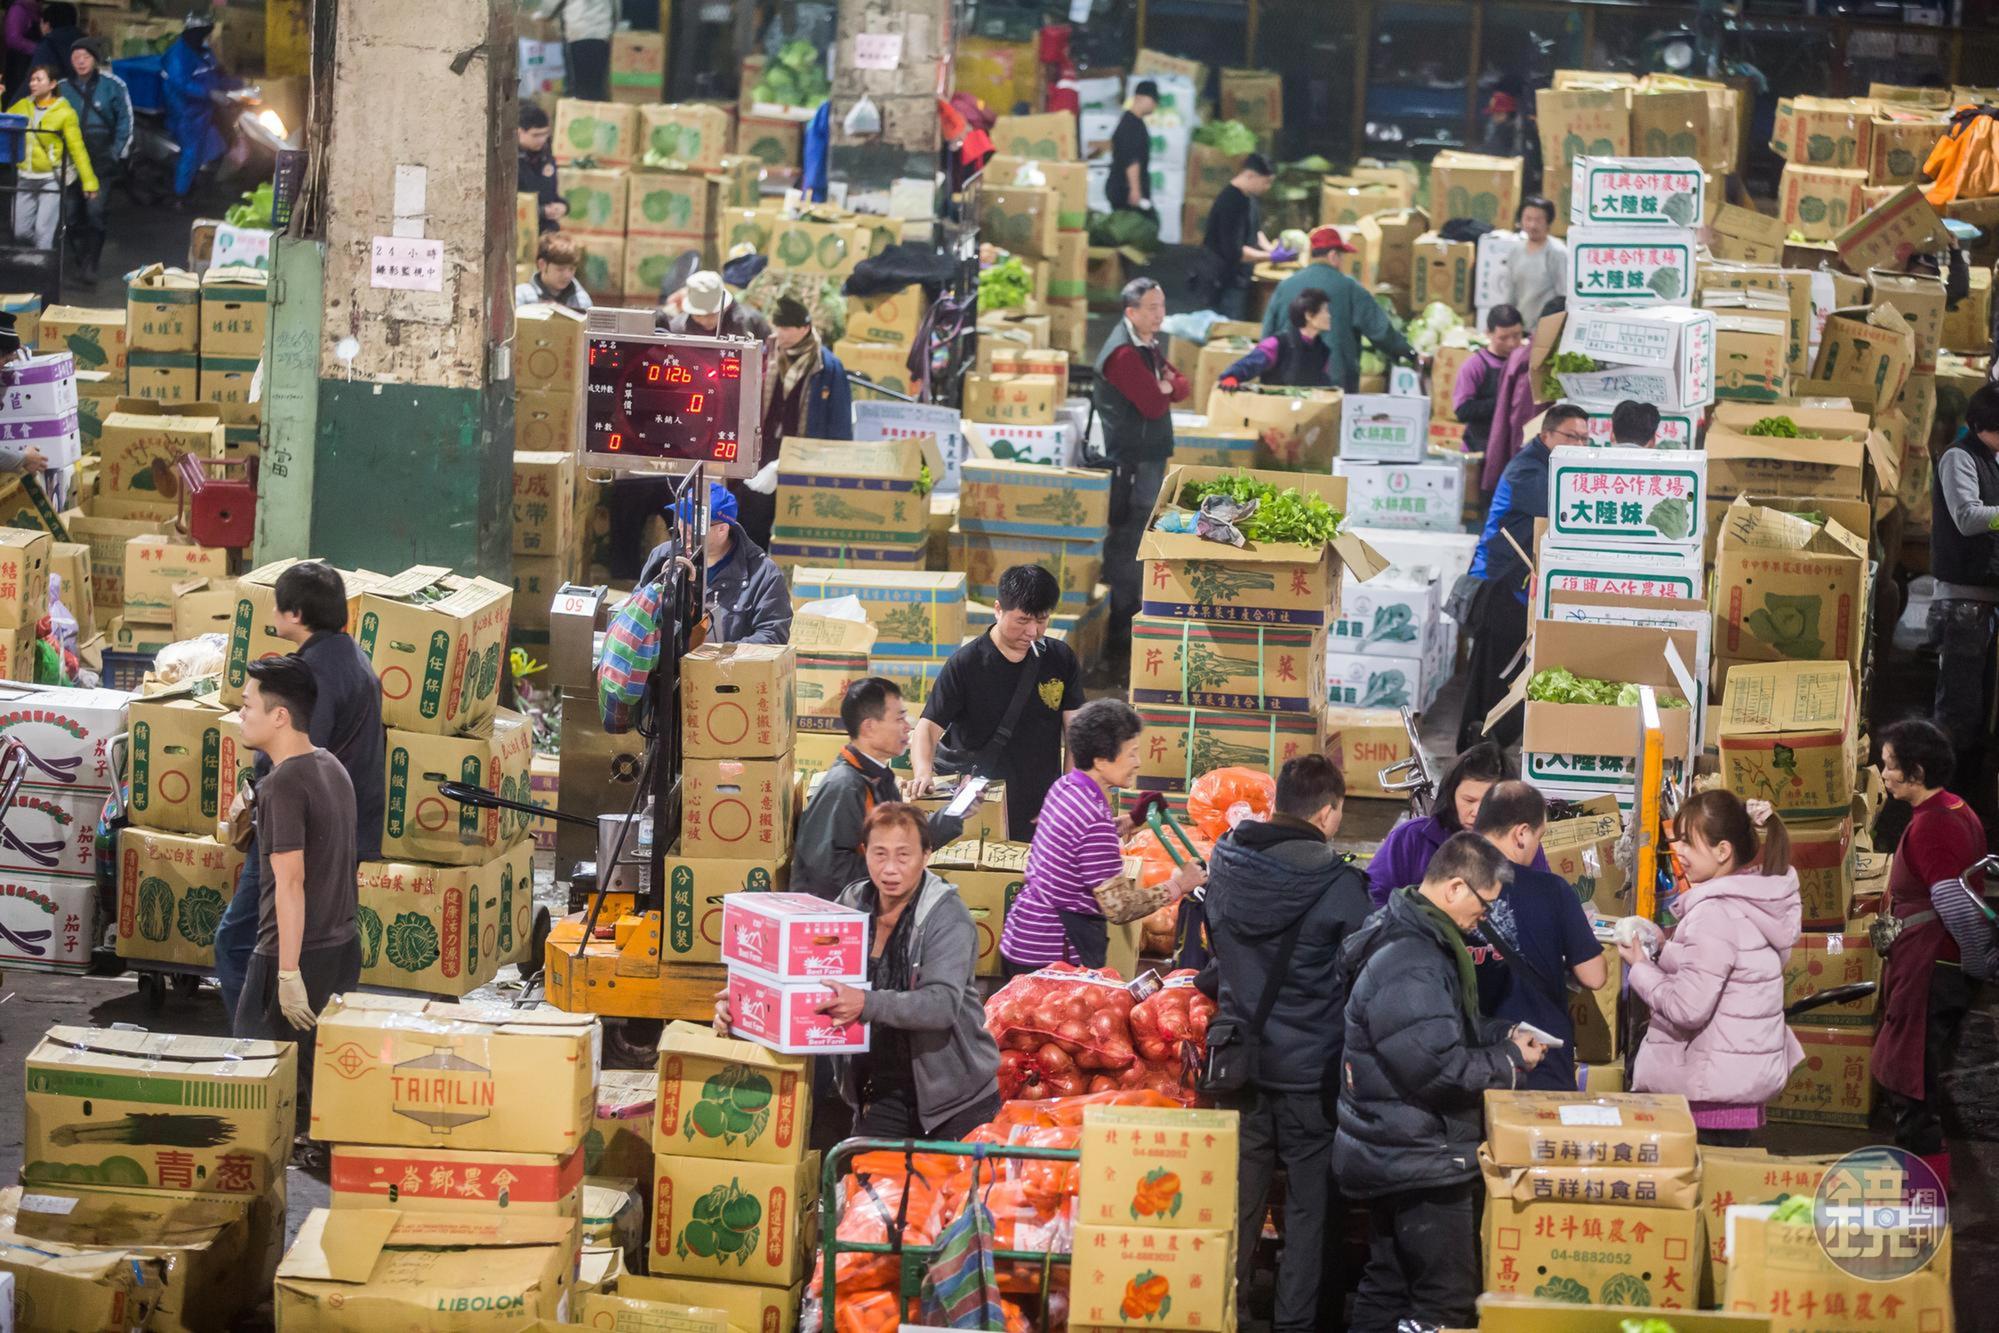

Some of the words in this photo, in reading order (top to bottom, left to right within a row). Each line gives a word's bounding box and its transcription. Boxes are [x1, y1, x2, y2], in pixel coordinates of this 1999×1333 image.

[1602, 175, 1690, 192] 復興合作農場
[1602, 195, 1658, 214] 大陸妹
[1587, 250, 1677, 266] 復興合作農場
[1587, 270, 1644, 289] 大陸妹
[599, 341, 617, 349] 品名
[595, 422, 613, 431] 件數
[654, 414, 682, 424] 承銷人
[718, 431, 736, 440] 重量
[714, 442, 737, 458] 20
[1572, 474, 1685, 497] 復興合作農場
[1571, 500, 1643, 525] 大陸妹
[1291, 569, 1311, 595] 菜
[360, 616, 379, 658] 精緻
[1146, 648, 1164, 676] 芹
[1278, 655, 1297, 682] 菜
[1149, 736, 1168, 763] 芹
[1353, 741, 1397, 761] SHIN
[77, 825, 94, 864] 茄子
[676, 868, 691, 951] 分級包裝
[63, 914, 80, 952] 茄子
[806, 968, 822, 976] Best
[824, 967, 843, 976] Farm
[827, 1037, 846, 1046] Farm
[1536, 1141, 1659, 1163] 吉祥村食品
[369, 1166, 519, 1198] 二崙鄉農會
[1533, 1178, 1657, 1201] 吉祥村食品
[1535, 1215, 1654, 1244] 北斗鎮農會
[1551, 1249, 1632, 1265] 04-8882052
[437, 1296, 524, 1312] LIBOLON
